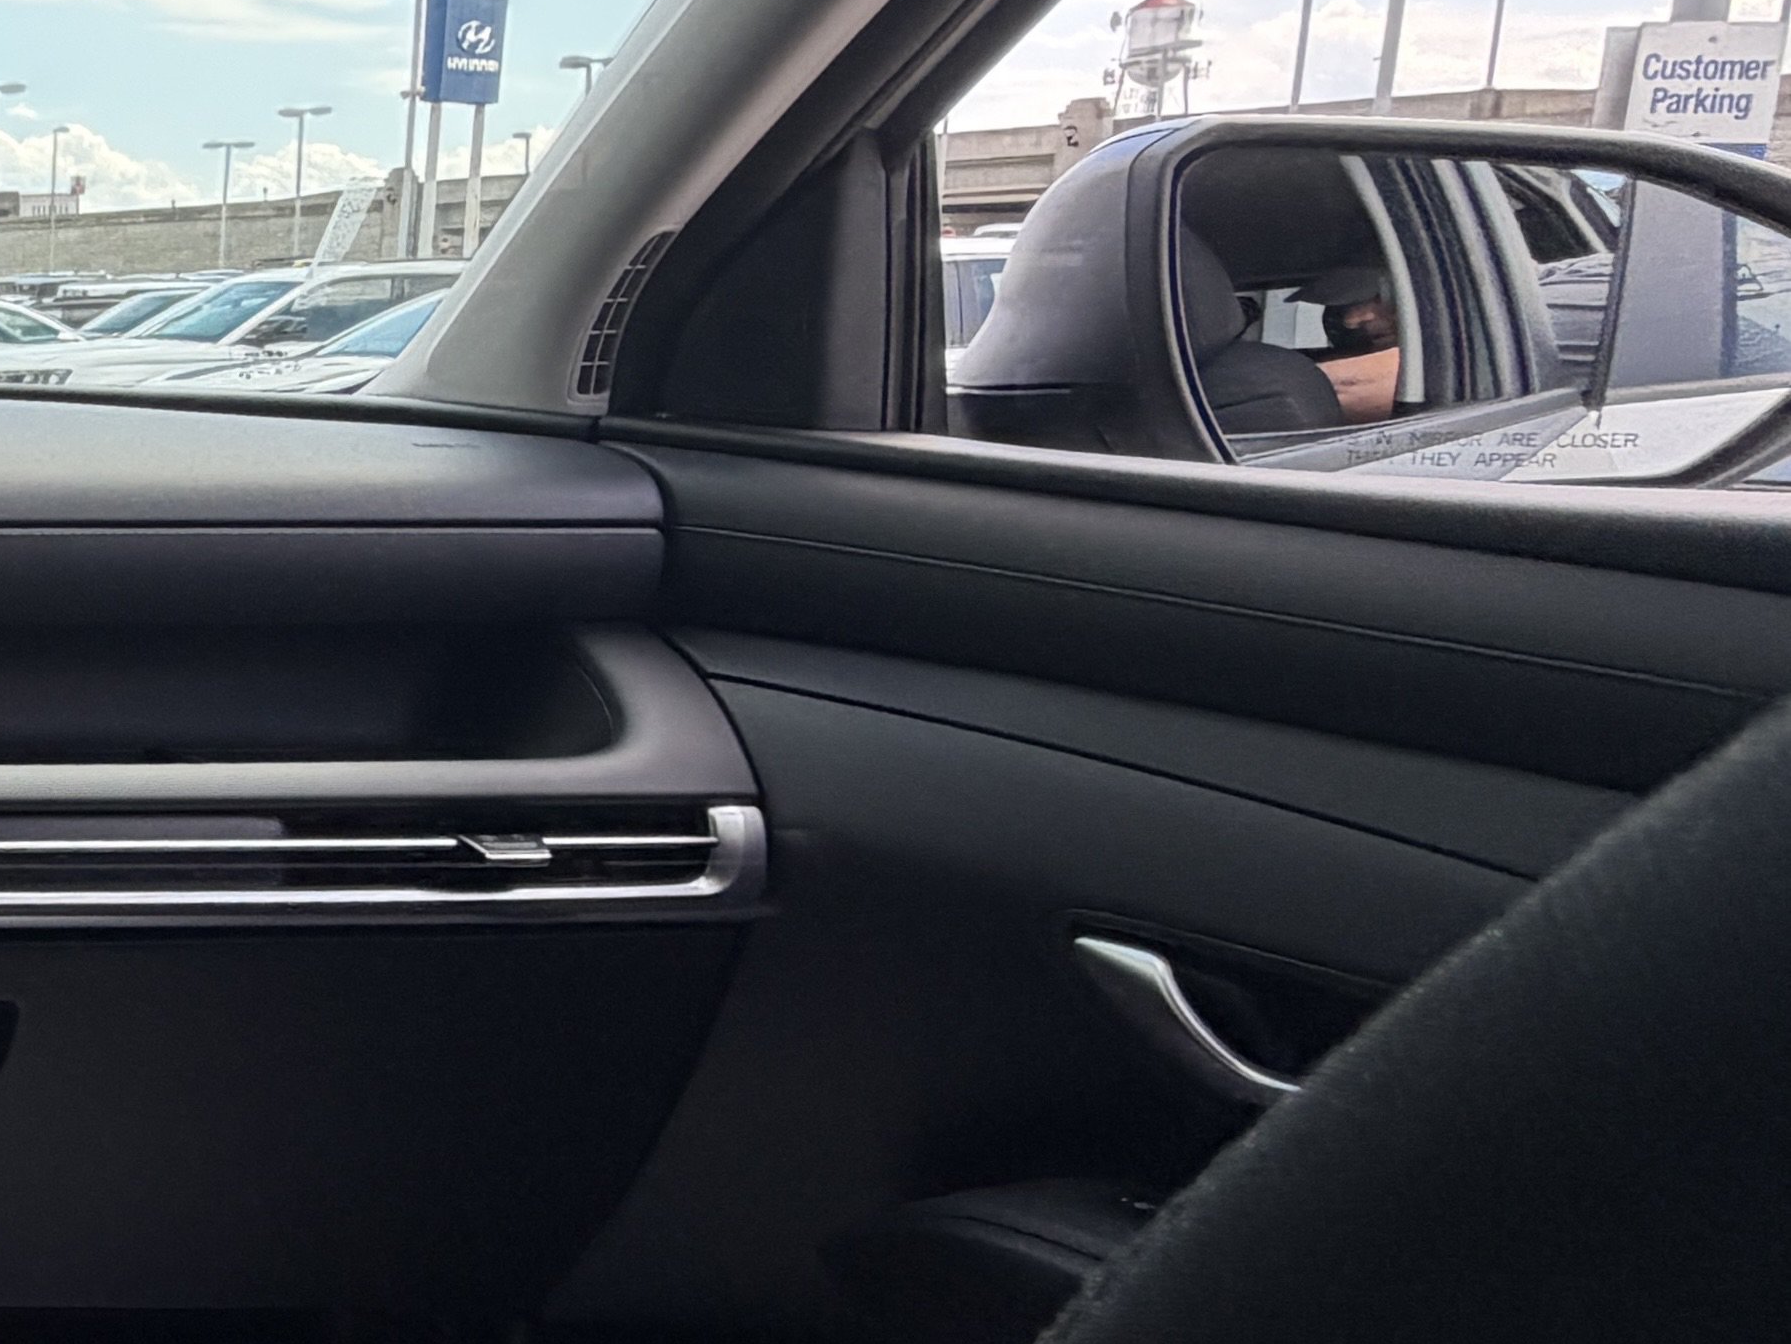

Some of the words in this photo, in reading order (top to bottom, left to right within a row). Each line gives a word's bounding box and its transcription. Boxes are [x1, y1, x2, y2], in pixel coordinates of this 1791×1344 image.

[1642, 53, 1775, 81] Customer
[1649, 87, 1752, 120] Parking
[1499, 433, 1538, 447] ARE
[1557, 433, 1639, 448] CLOSER
[1411, 453, 1460, 467] THEY
[1474, 454, 1556, 468] APPEAR
